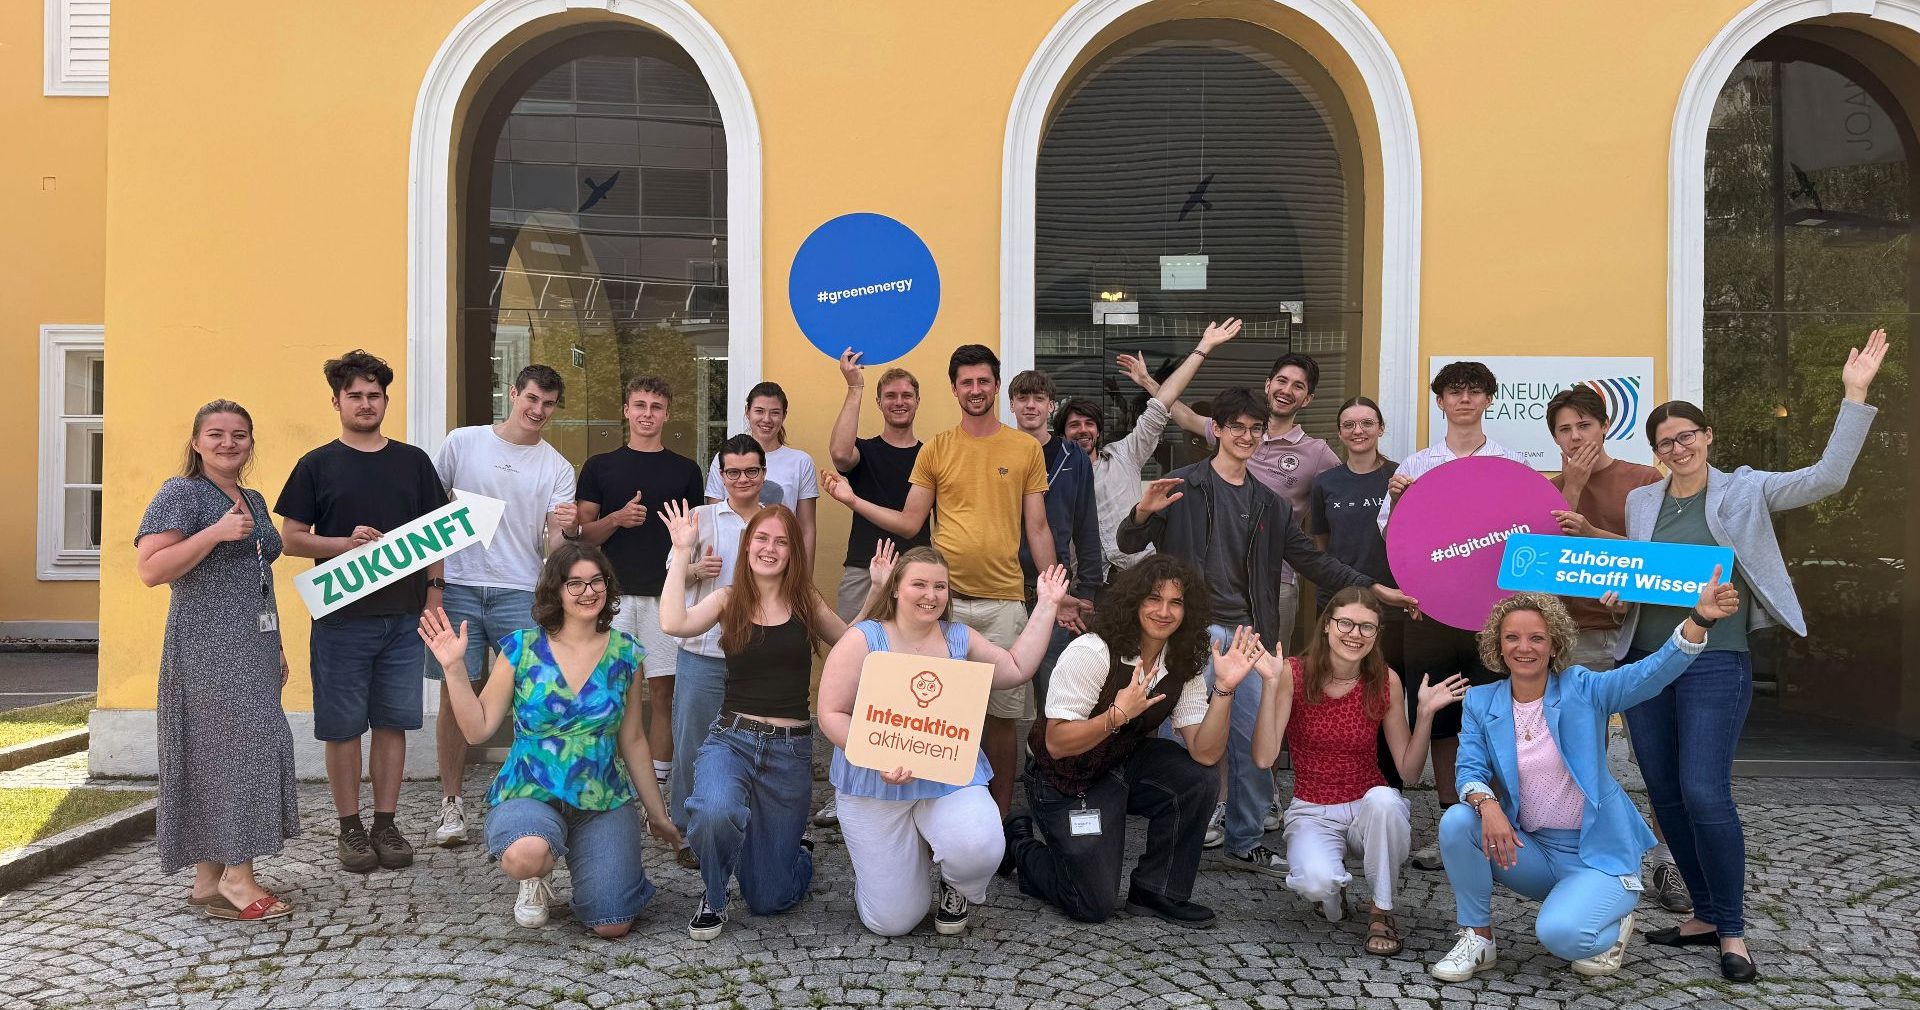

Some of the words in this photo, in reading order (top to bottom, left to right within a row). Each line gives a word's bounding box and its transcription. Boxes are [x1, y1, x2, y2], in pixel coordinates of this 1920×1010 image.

[1844, 81, 1872, 150] JOA
[817, 278, 913, 304] #greenenergy
[1493, 382, 1561, 400] NEUM
[312, 506, 475, 605] ZUKUNFT
[1430, 524, 1531, 562] #digitaltwin
[1559, 548, 1644, 570] Zuhören
[1555, 569, 1628, 587] schafft
[865, 704, 970, 742] Interaktion
[868, 730, 959, 761] aktivieren!
